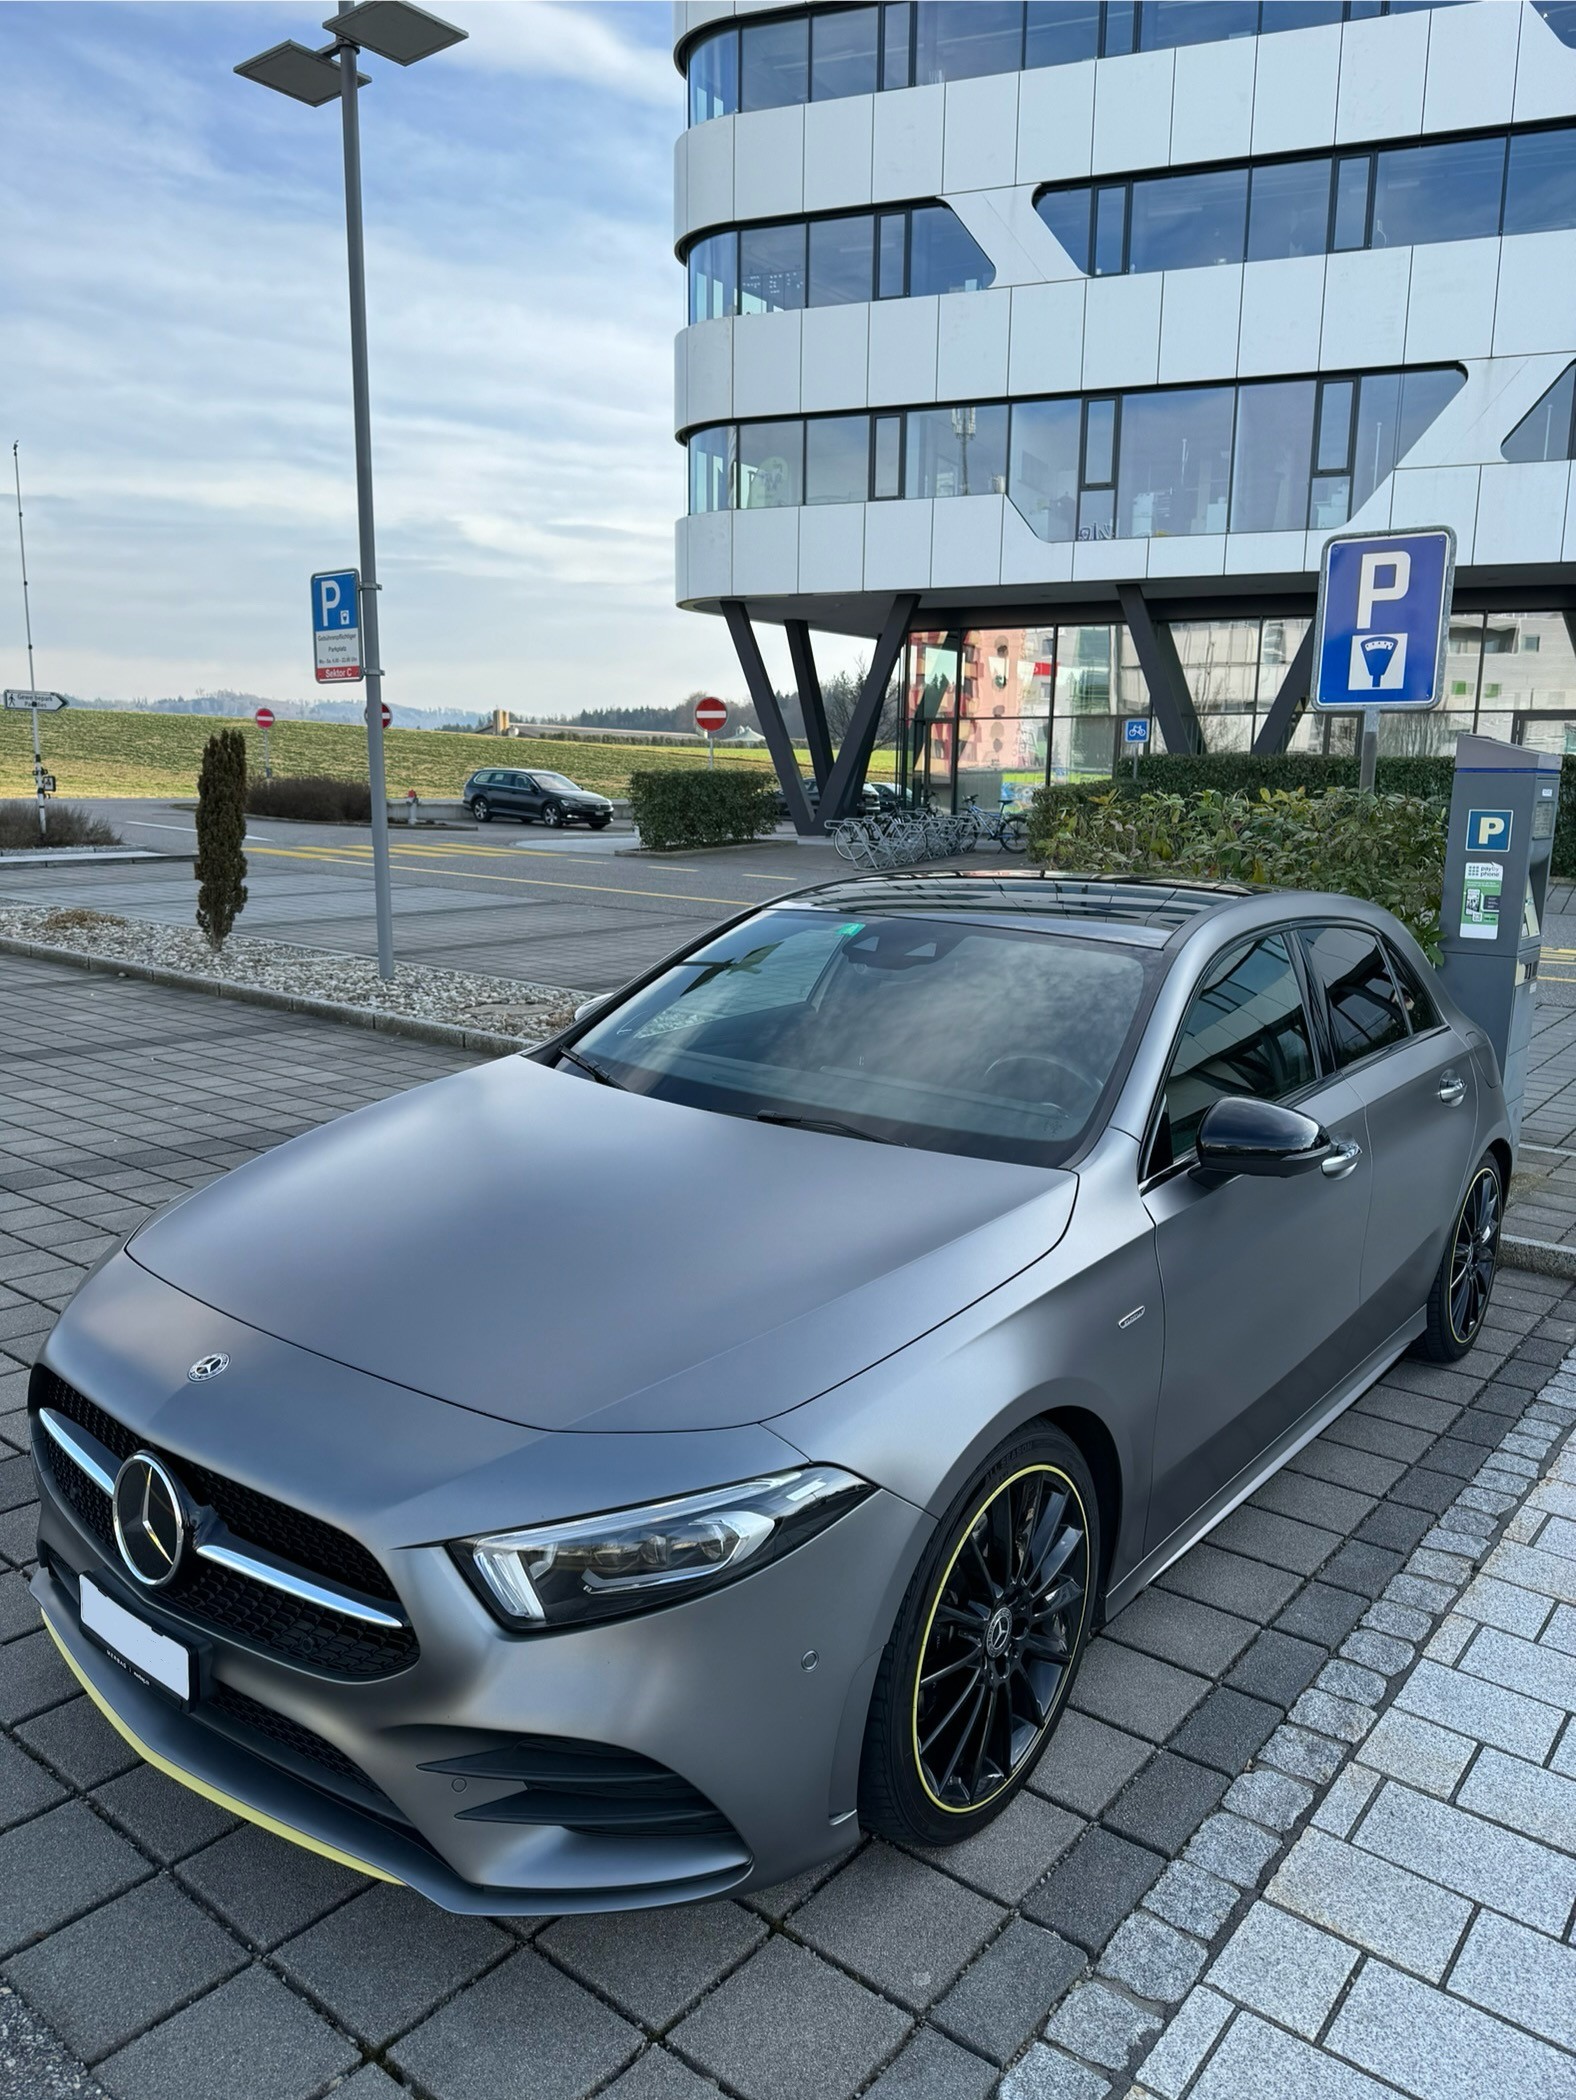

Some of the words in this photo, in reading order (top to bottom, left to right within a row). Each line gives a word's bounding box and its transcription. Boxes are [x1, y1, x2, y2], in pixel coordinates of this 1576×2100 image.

[321, 580, 341, 627] P
[1356, 550, 1411, 629] P
[325, 669, 346, 678] Sektor
[346, 667, 353, 677] C
[17, 693, 53, 702] Gewebepark
[1478, 816, 1505, 845] P
